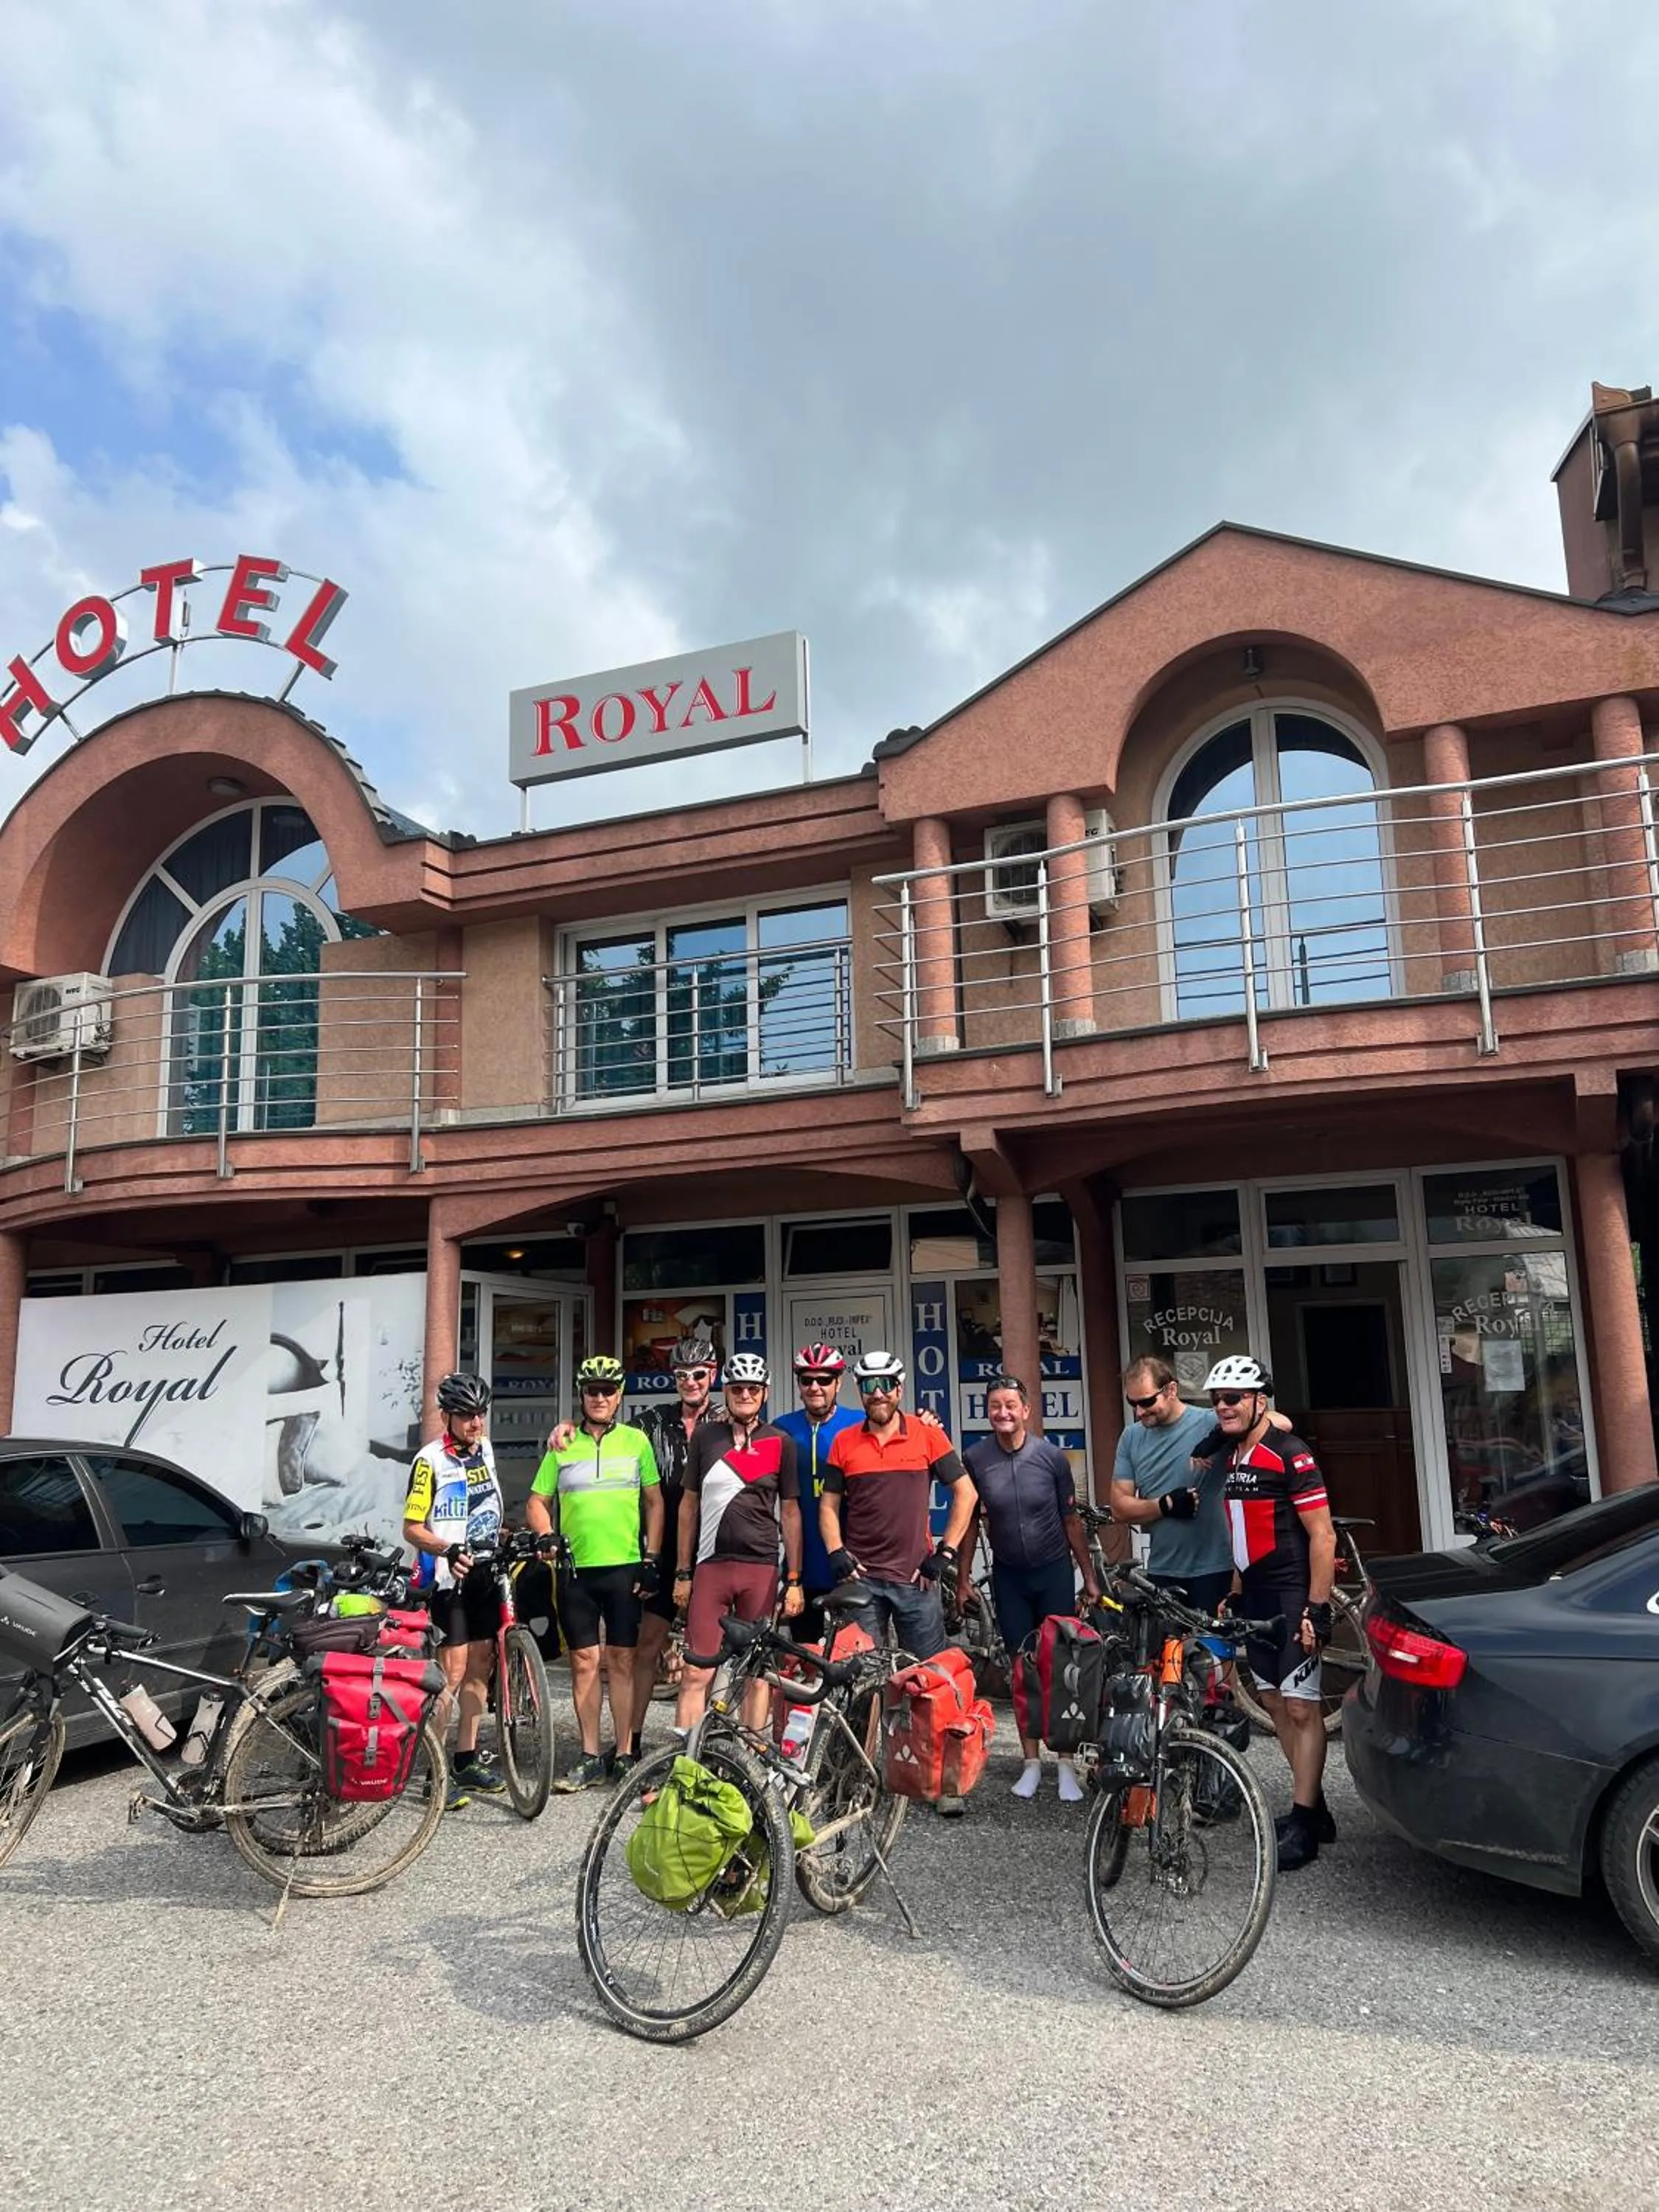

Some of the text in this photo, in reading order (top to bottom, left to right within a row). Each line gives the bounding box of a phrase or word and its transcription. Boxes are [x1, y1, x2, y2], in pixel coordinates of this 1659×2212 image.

[0, 554, 348, 755] HOTEL
[531, 666, 776, 757] ROYAL
[1464, 1202, 1521, 1215] HOTEL
[138, 1318, 227, 1352] Hotel
[821, 1327, 858, 1339] HOTEL
[1144, 1306, 1234, 1334] RECEPCIJA
[1162, 1326, 1222, 1351] Royal
[46, 1345, 237, 1447] Royal
